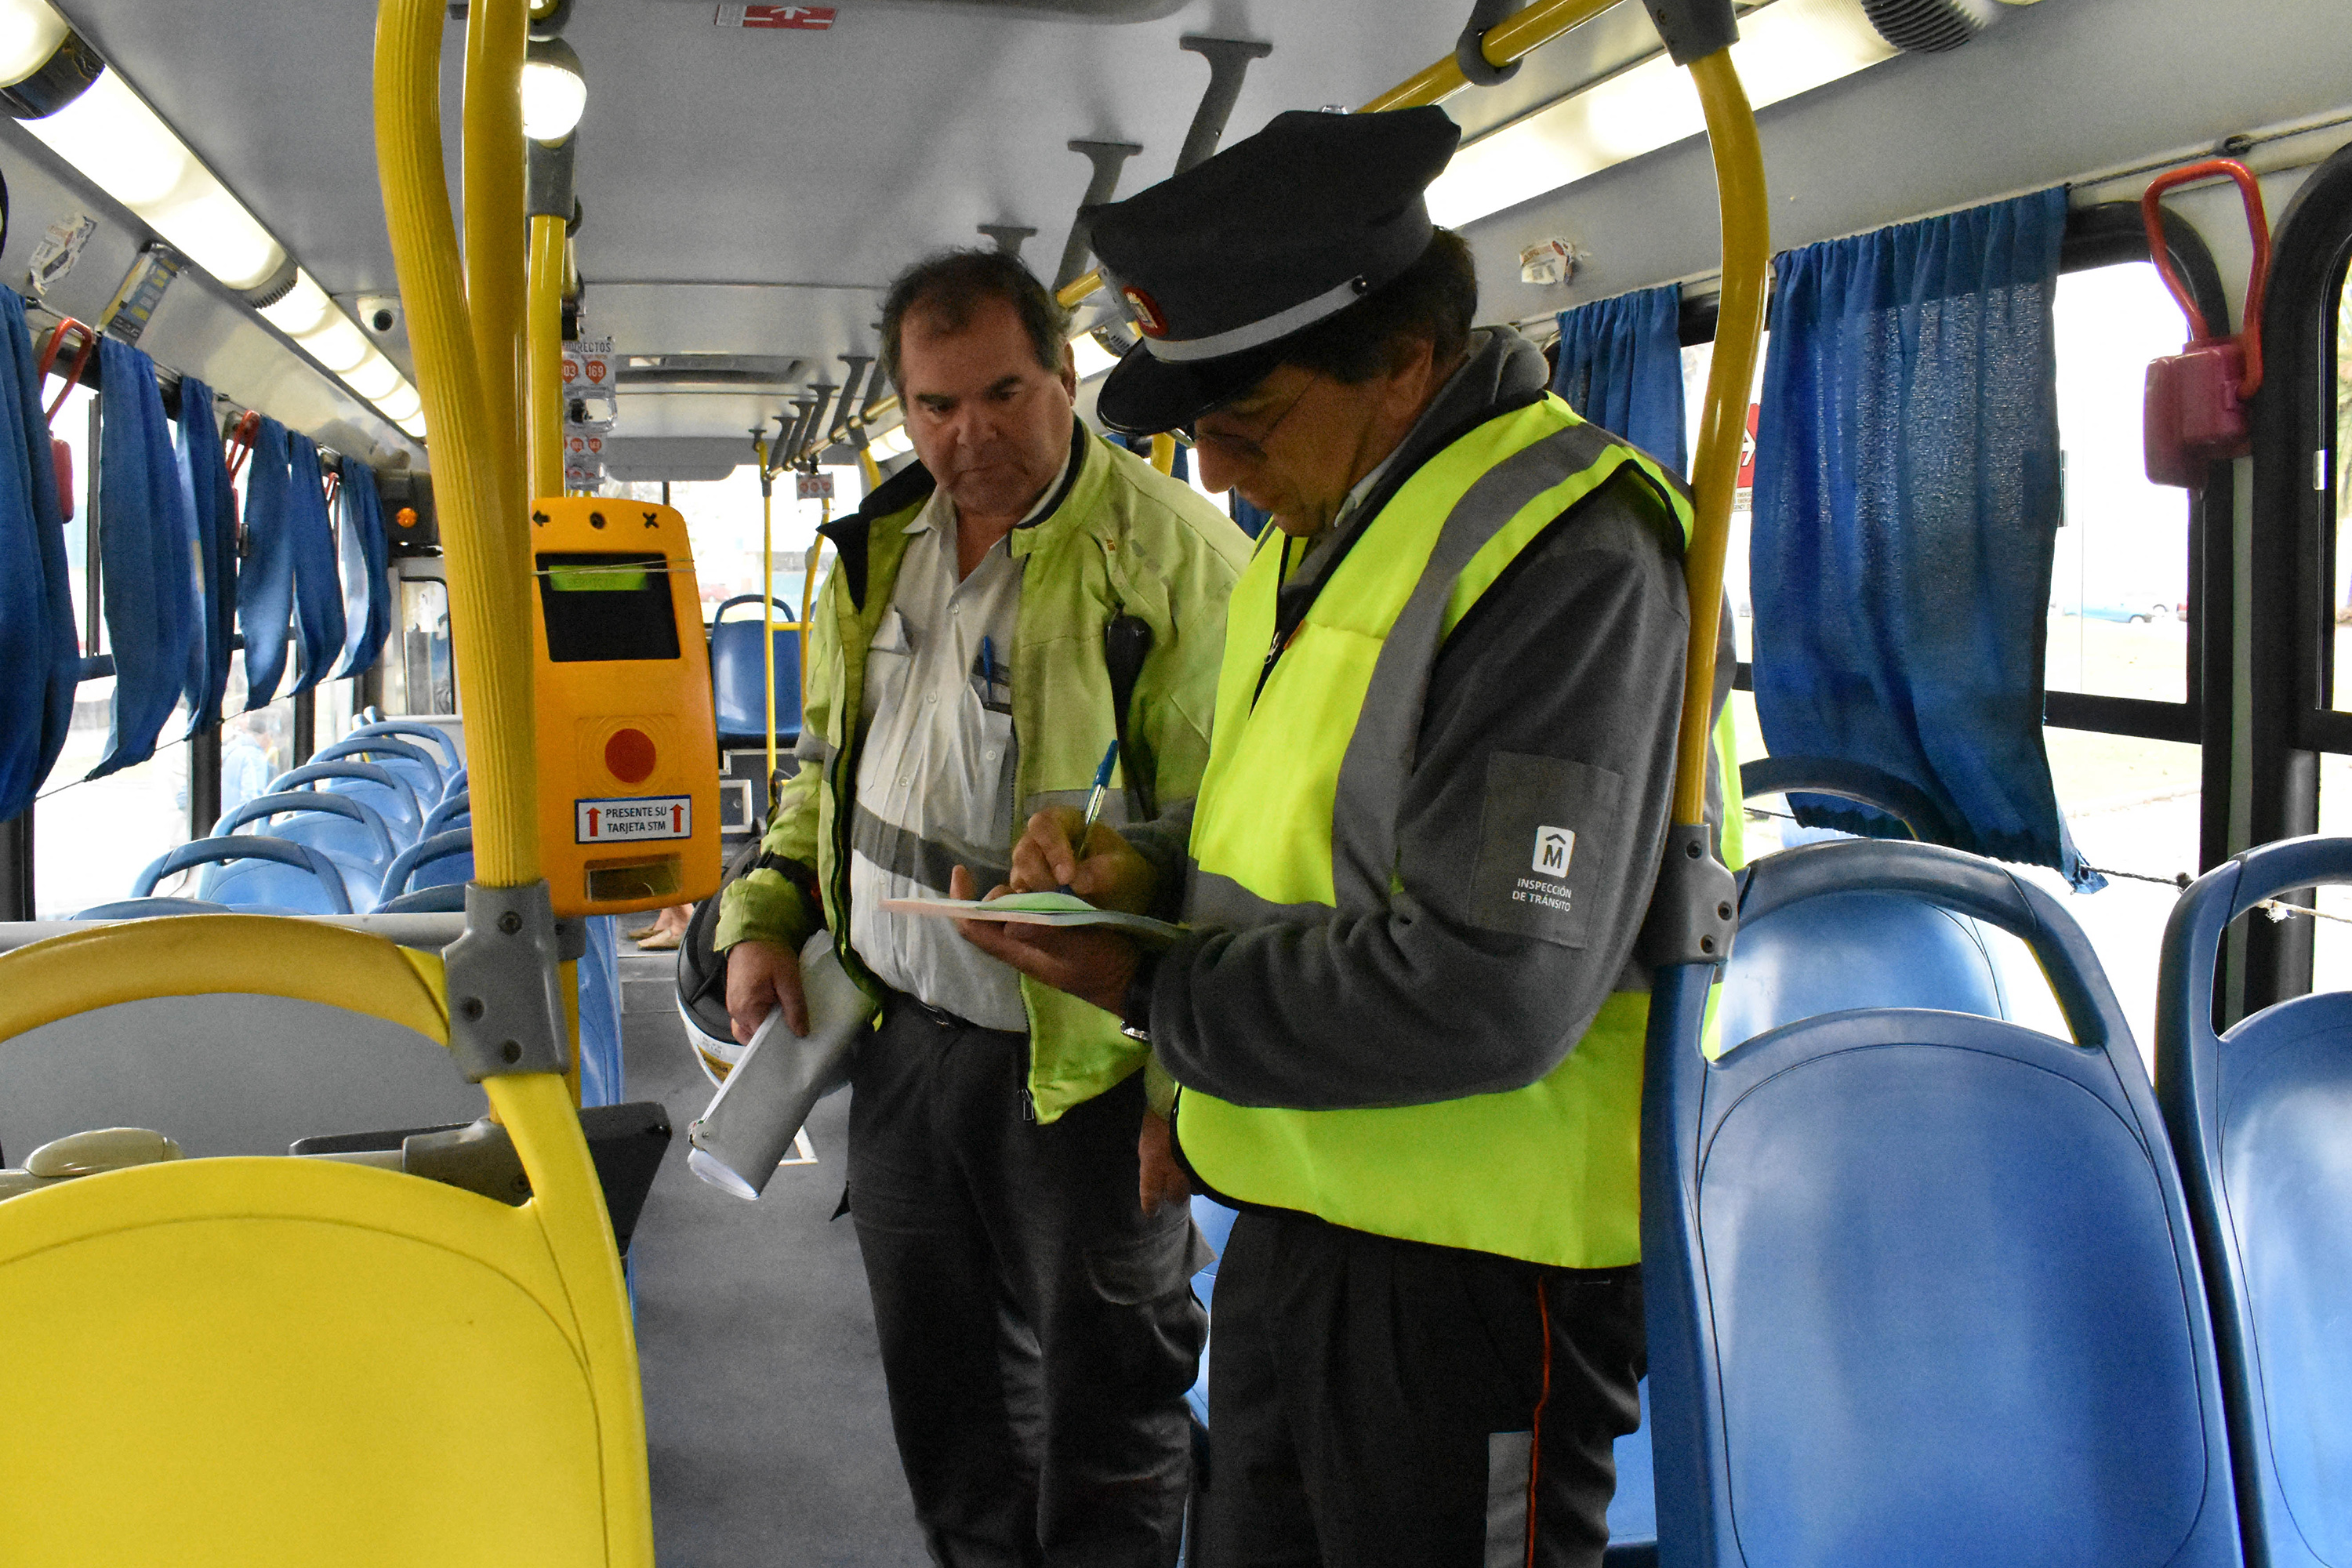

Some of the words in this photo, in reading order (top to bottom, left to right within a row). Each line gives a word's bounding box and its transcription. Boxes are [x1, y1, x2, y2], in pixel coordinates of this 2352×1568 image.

[588, 365, 604, 377] 169
[605, 807, 652, 818] PRESENTE
[655, 806, 667, 816] SU
[607, 822, 645, 834] TARJETA
[648, 821, 666, 831] STM
[1517, 878, 1572, 898] INSPECCIÓN
[1512, 891, 1526, 902] DE
[1528, 894, 1571, 912] TRÁNSITO
